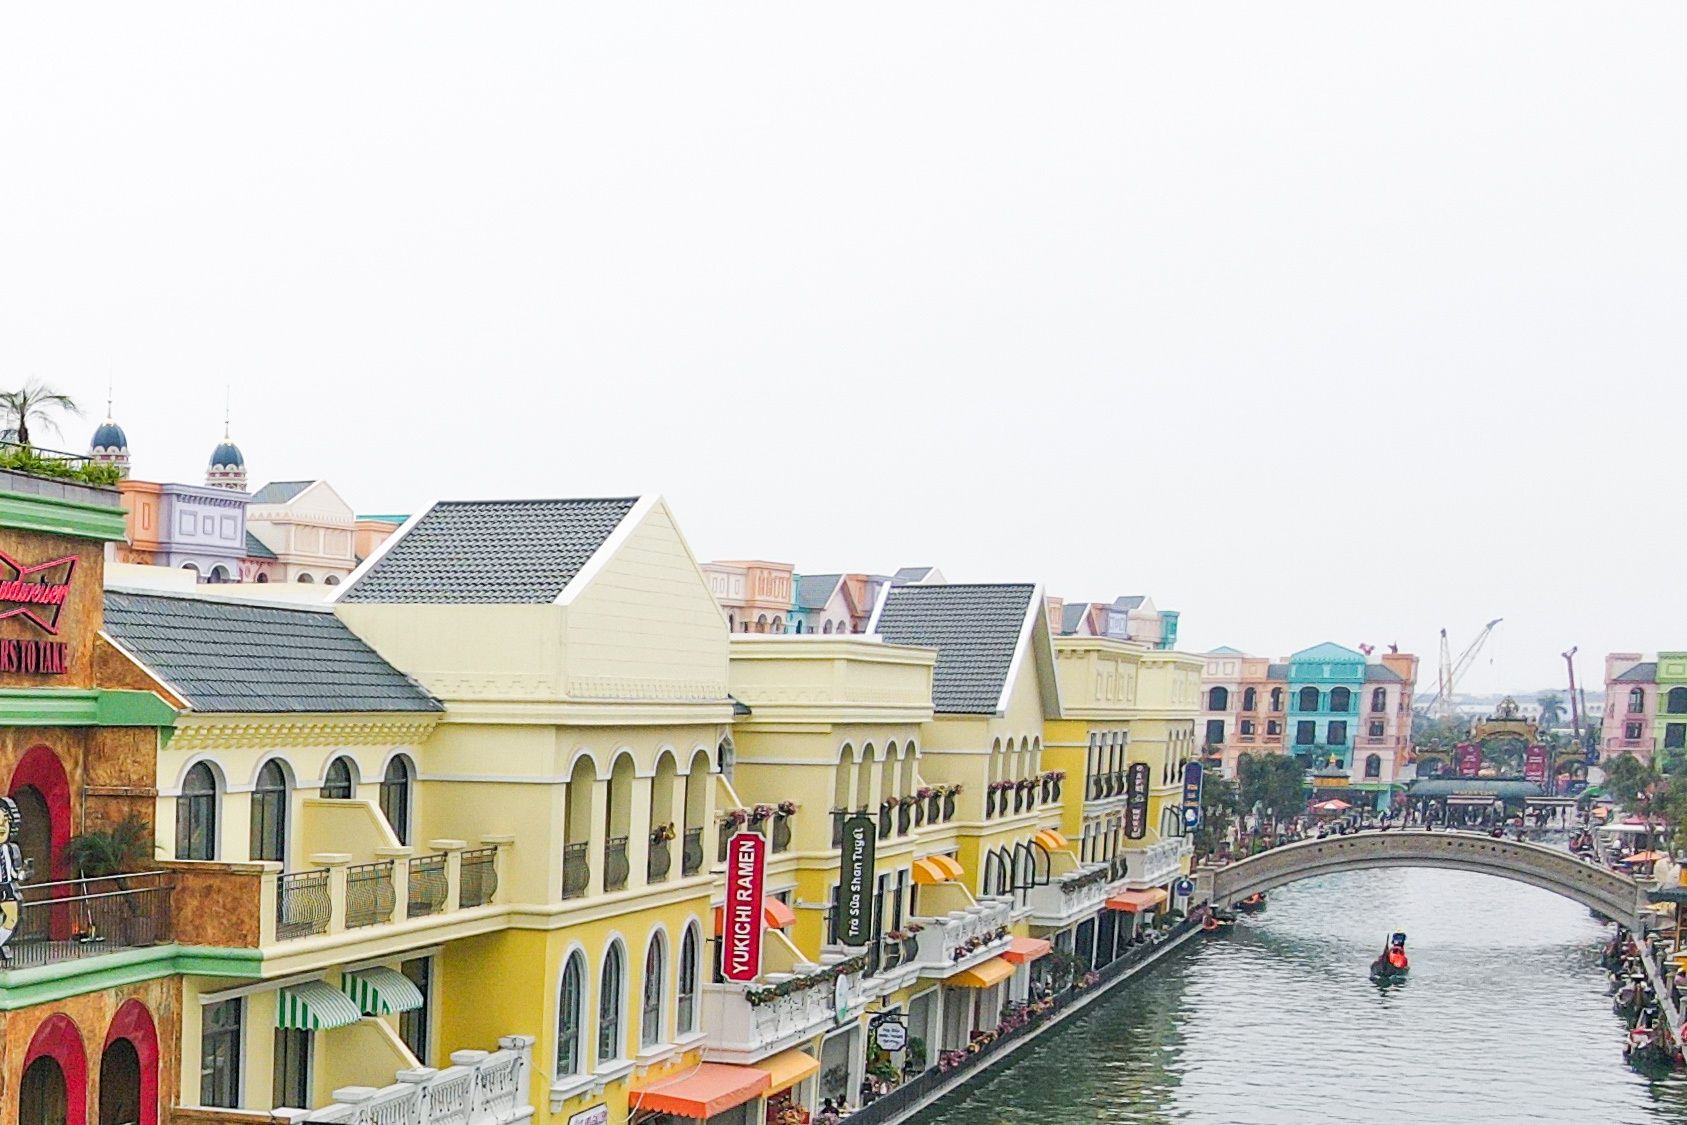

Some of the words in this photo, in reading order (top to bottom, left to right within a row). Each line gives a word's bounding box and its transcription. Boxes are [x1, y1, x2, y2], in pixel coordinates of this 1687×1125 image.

[20, 641, 37, 673] TO
[38, 641, 68, 673] TAKE
[736, 840, 755, 901] RAMEN
[851, 863, 862, 892] Shan
[733, 906, 752, 974] YUKICHI
